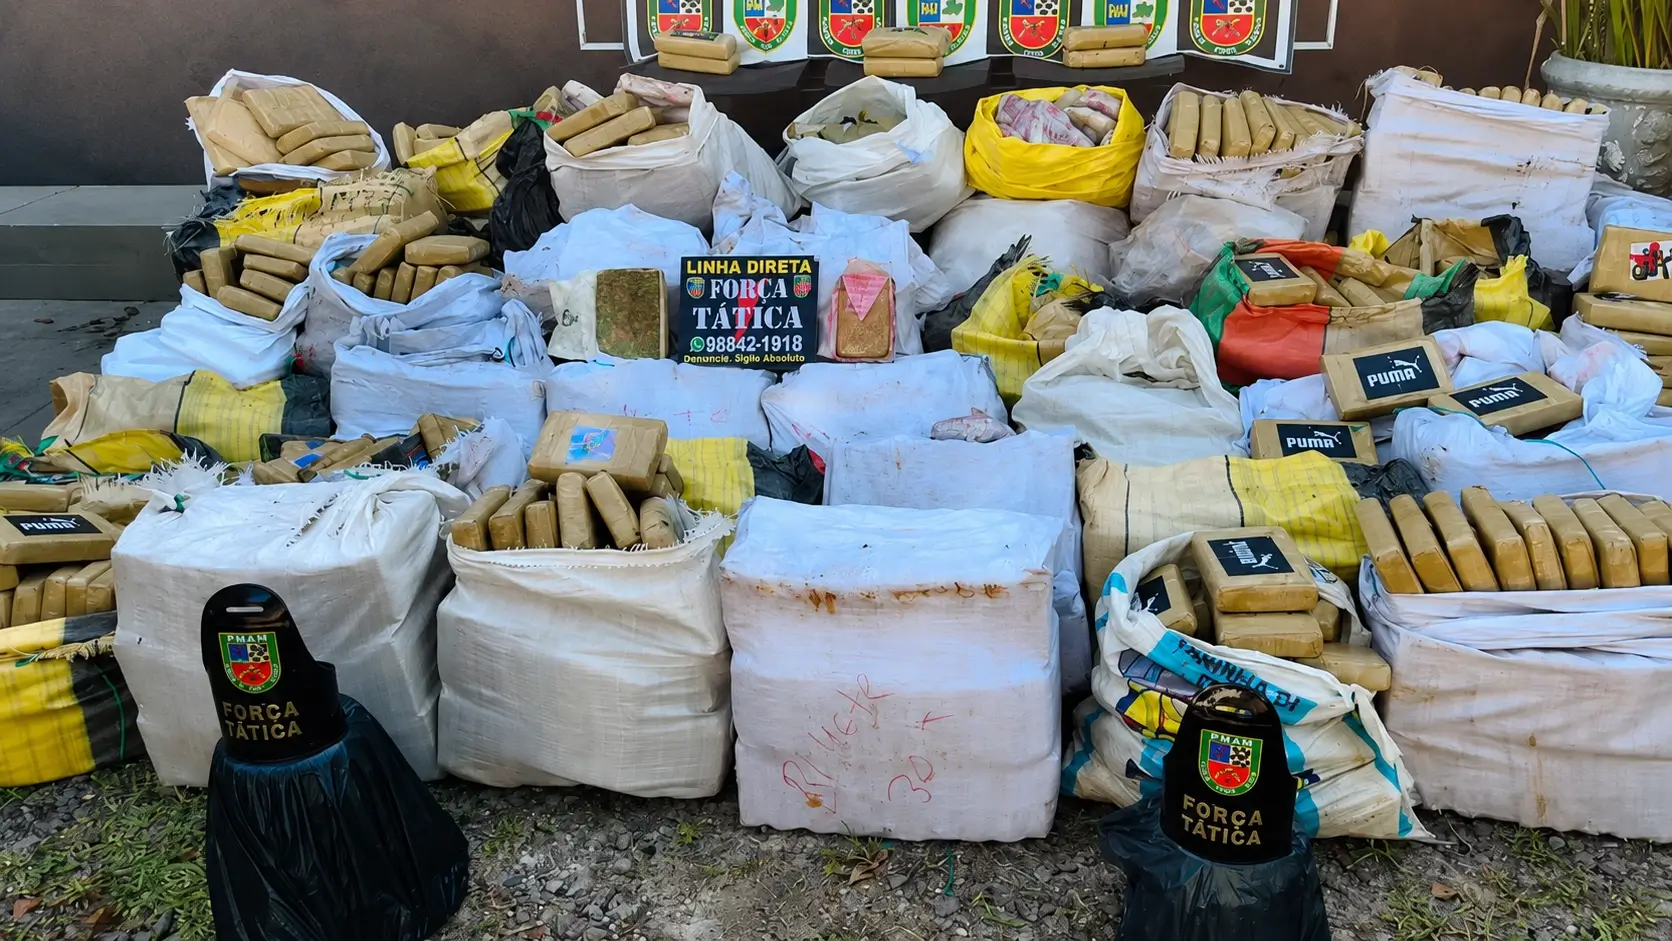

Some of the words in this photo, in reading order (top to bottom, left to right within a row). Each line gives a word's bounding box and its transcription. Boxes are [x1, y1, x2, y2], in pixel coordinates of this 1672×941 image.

[686, 260, 742, 274] LINHA
[748, 260, 812, 274] DIRETA
[710, 278, 788, 304] FORÇA
[692, 302, 803, 330] TÁTICA
[706, 335, 802, 352] 98842-1918
[763, 354, 805, 362] Absoluto
[1367, 367, 1417, 388] PUMA
[1468, 390, 1519, 409] PUMA
[1286, 436, 1335, 449] PUMA
[20, 522, 76, 531] PUMA
[227, 634, 267, 643] PMAM
[222, 701, 300, 723] FORÇA
[1210, 733, 1253, 747] PMAM
[1182, 794, 1263, 829] FORÇA
